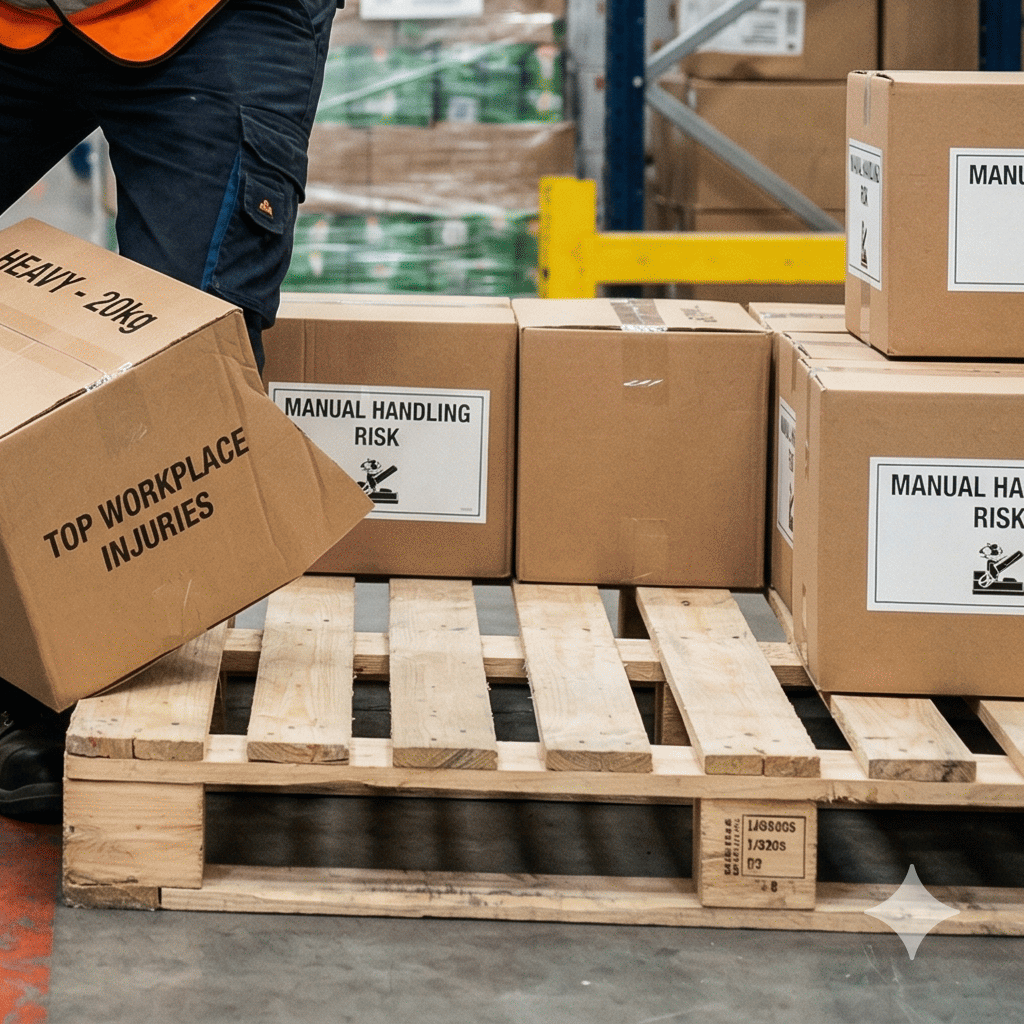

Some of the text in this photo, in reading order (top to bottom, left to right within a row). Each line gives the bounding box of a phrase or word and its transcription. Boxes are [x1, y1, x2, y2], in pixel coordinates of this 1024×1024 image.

[83, 291, 158, 334] 20kg
[285, 397, 471, 424] MANUAL HANDLING
[354, 426, 400, 447] RISK
[43, 427, 251, 559] TOP WORKPLACE
[890, 474, 1024, 498] MANUAL HA
[974, 506, 1024, 529] RISK
[101, 491, 215, 573] INJURIES
